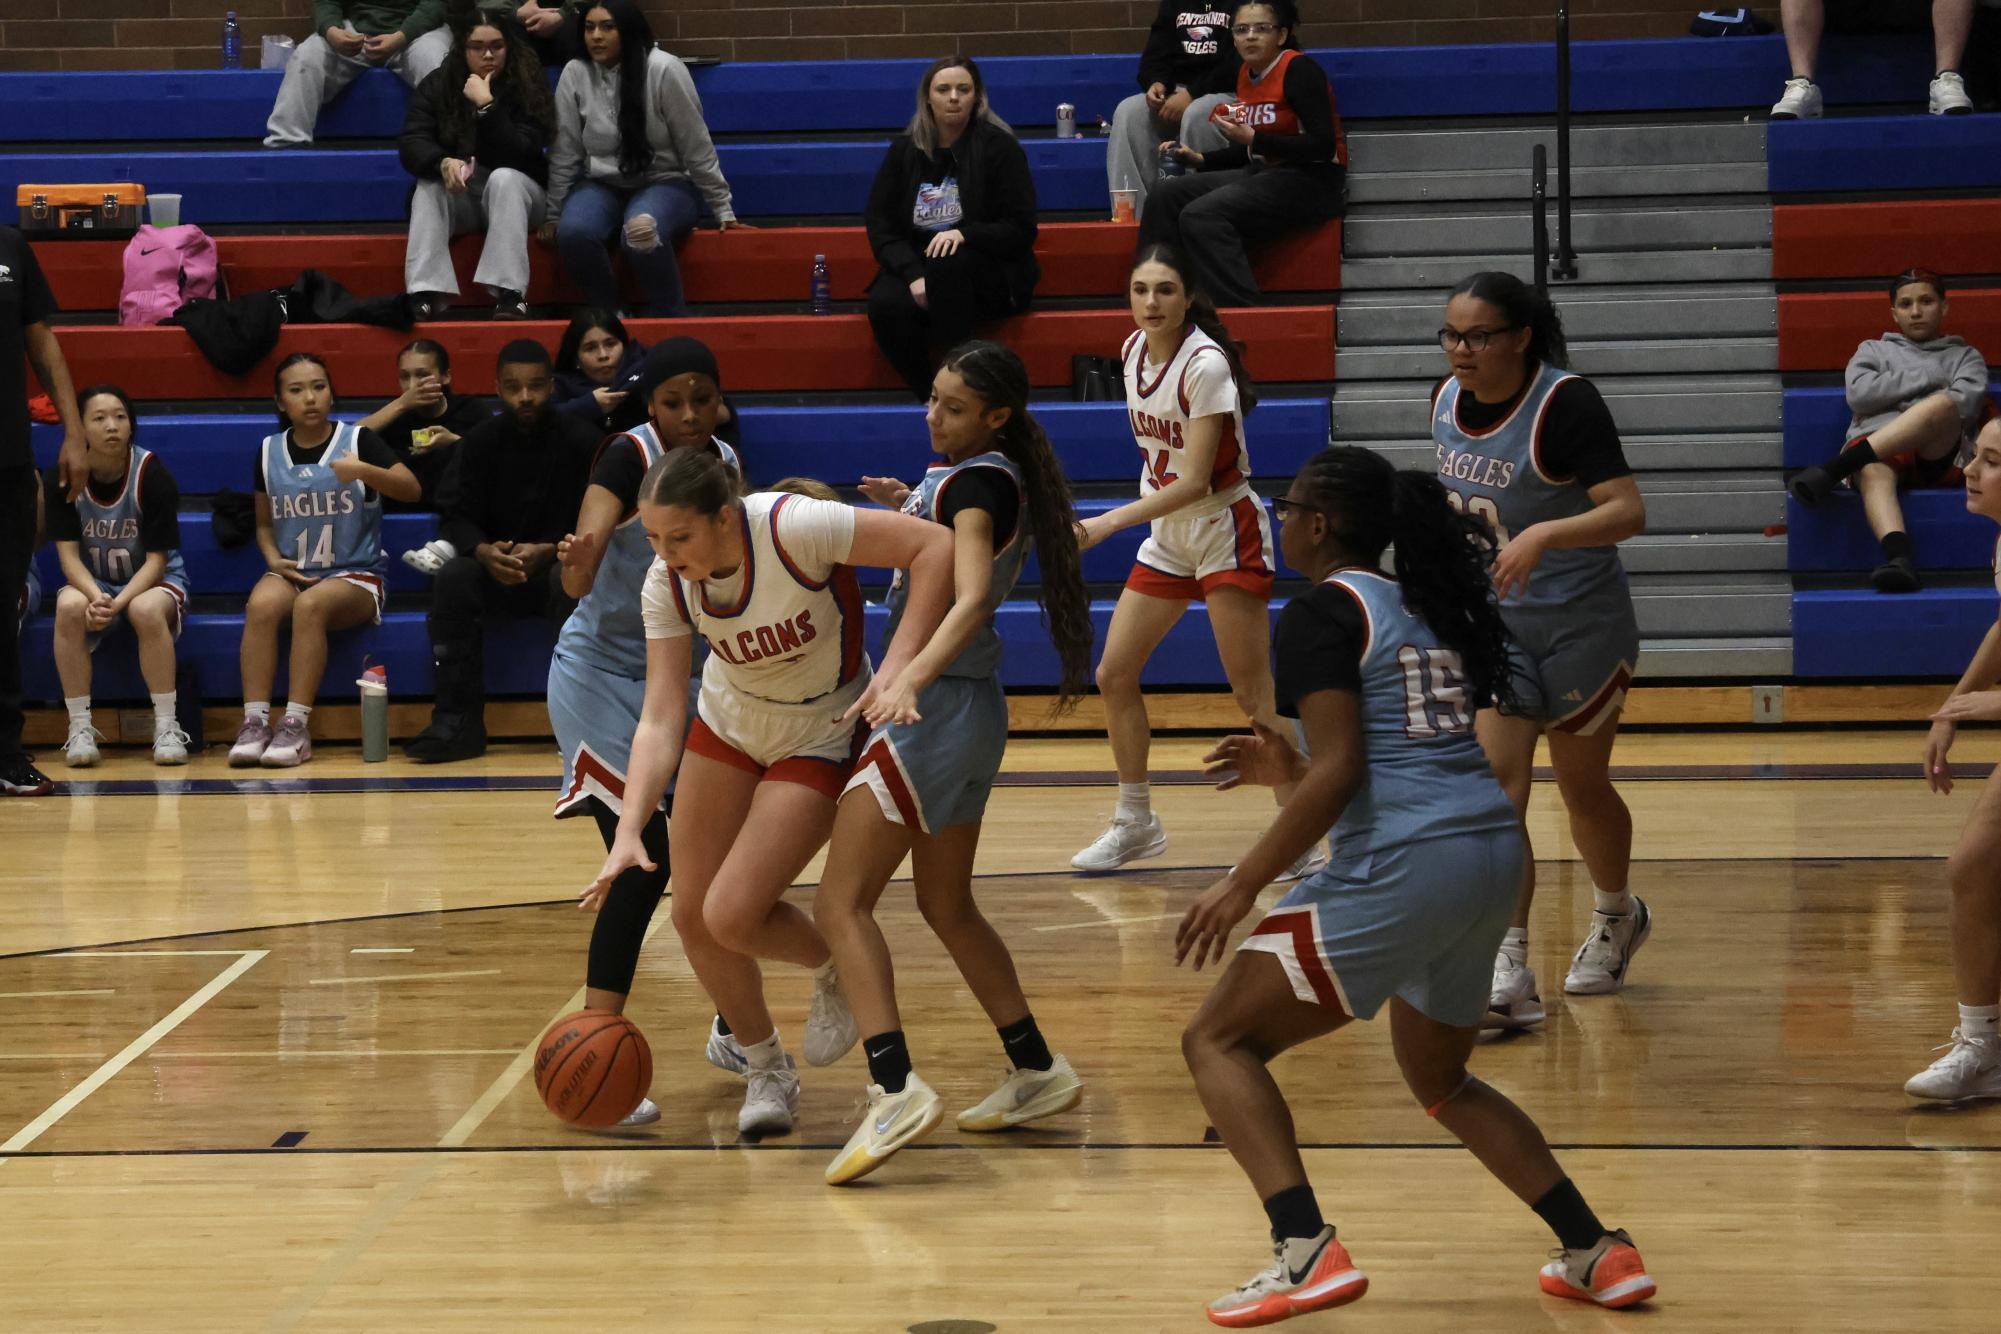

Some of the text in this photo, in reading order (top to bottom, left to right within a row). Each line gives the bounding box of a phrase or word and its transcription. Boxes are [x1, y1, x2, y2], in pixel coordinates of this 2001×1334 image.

[1130, 408, 1184, 450] LCONS
[1436, 443, 1516, 489] EAGLES
[271, 489, 355, 520] EAGLES
[81, 517, 139, 539] AGLES
[295, 524, 336, 570] 14
[88, 545, 136, 582] 10
[712, 608, 817, 665] LCONS
